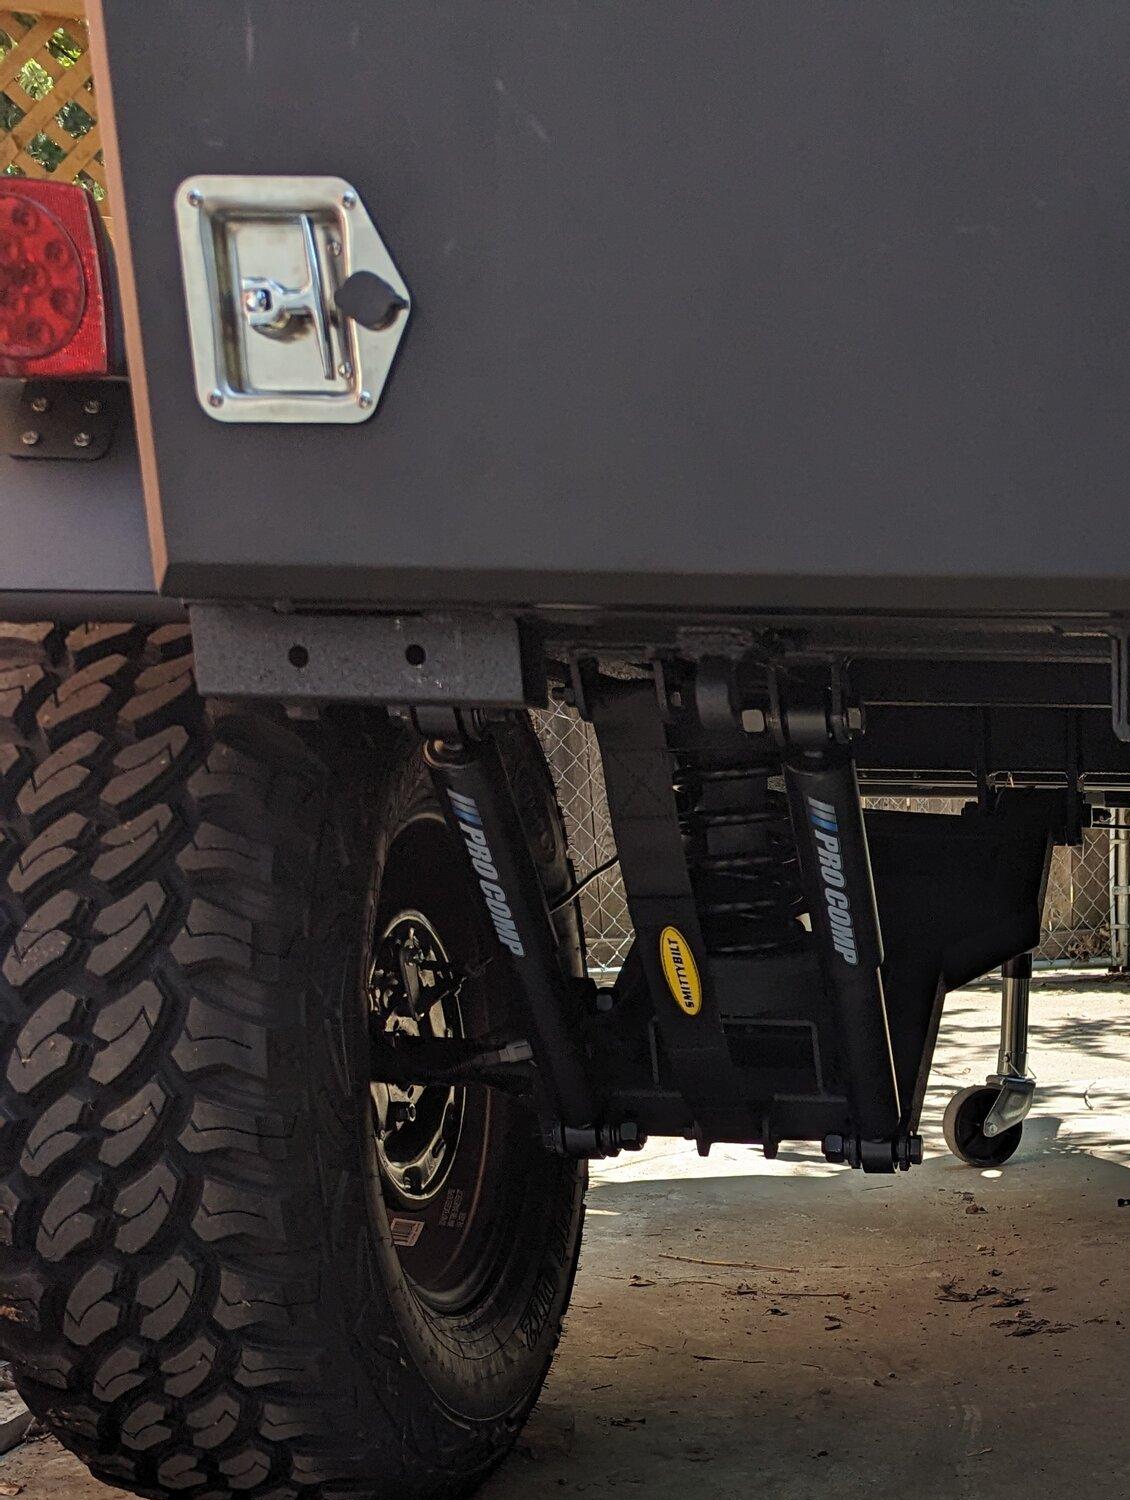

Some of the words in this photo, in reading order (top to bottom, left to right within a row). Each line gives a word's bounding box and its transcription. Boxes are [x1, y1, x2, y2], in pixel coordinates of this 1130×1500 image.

[460, 823, 498, 881] PRO
[479, 880, 525, 958] COMP
[815, 829, 846, 888] PRO
[823, 887, 859, 967] COMP
[665, 938, 694, 1009] SMITTYBILT
